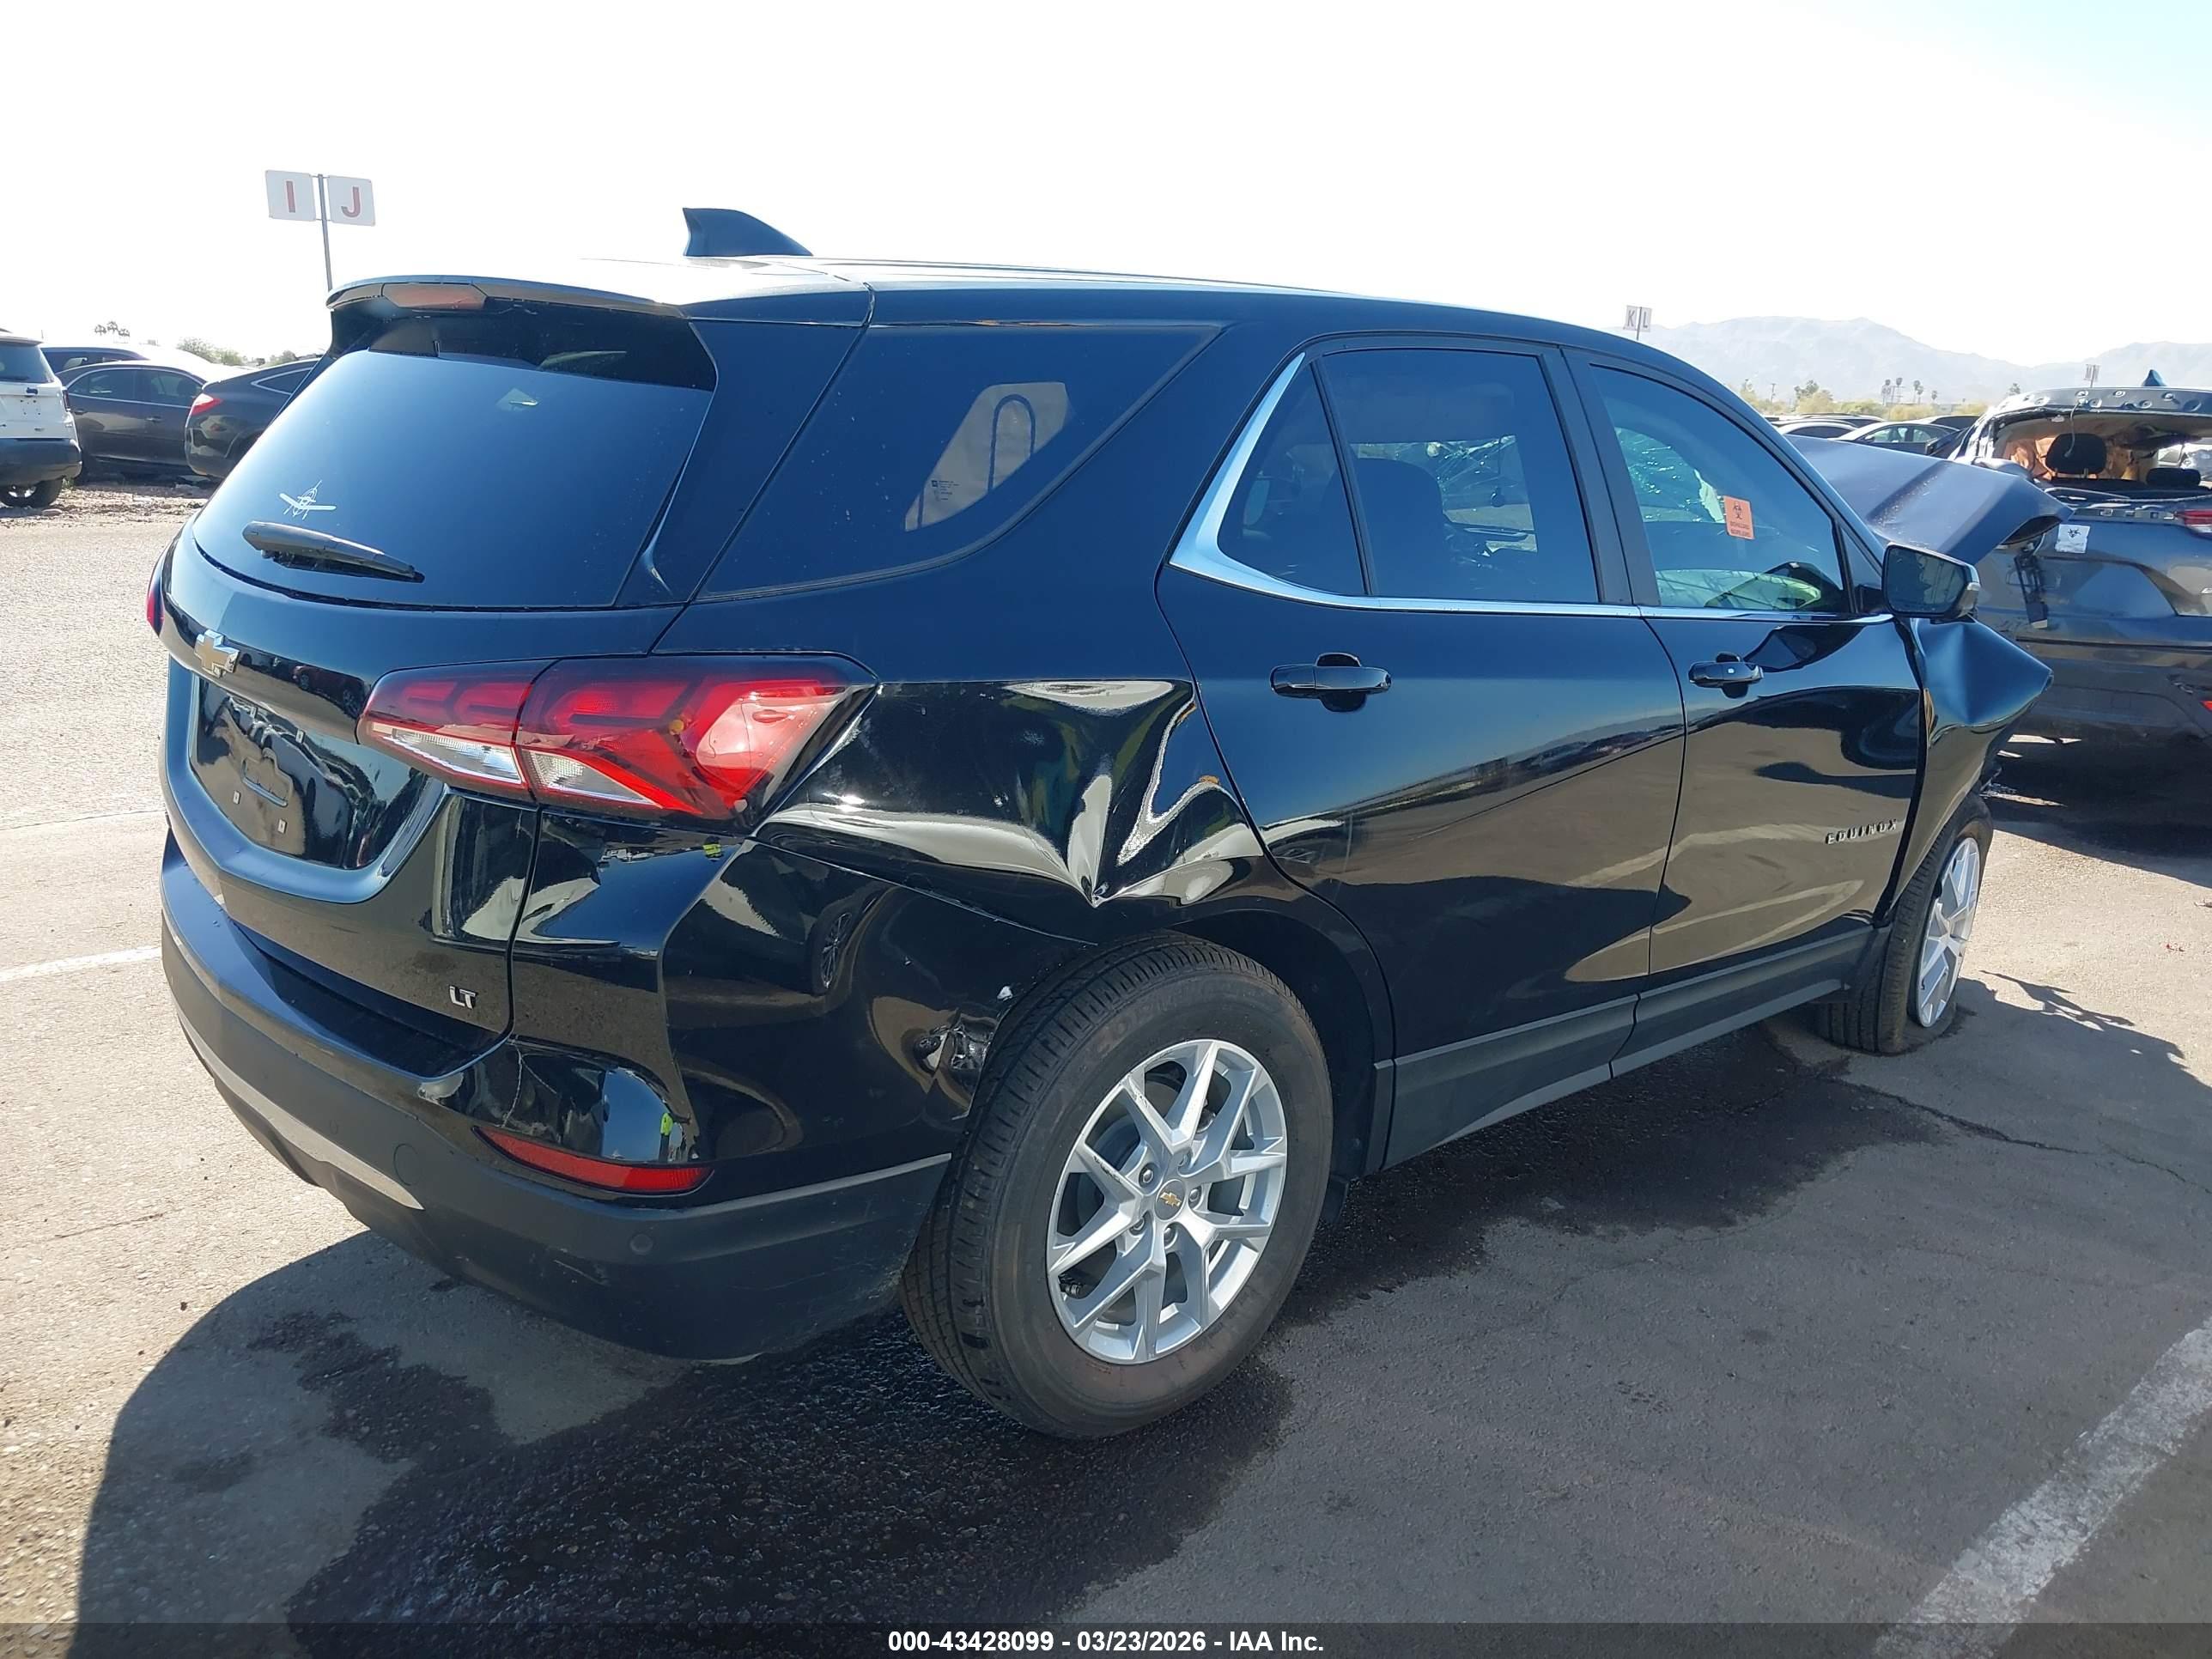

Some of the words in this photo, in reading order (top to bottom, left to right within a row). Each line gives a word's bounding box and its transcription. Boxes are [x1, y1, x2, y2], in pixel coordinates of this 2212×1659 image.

[286, 180, 296, 214] I
[341, 186, 361, 218] J
[1627, 309, 1636, 327] K
[1643, 311, 1649, 328] L
[1826, 819, 1896, 844] EQUINOX
[449, 986, 476, 1010] LT
